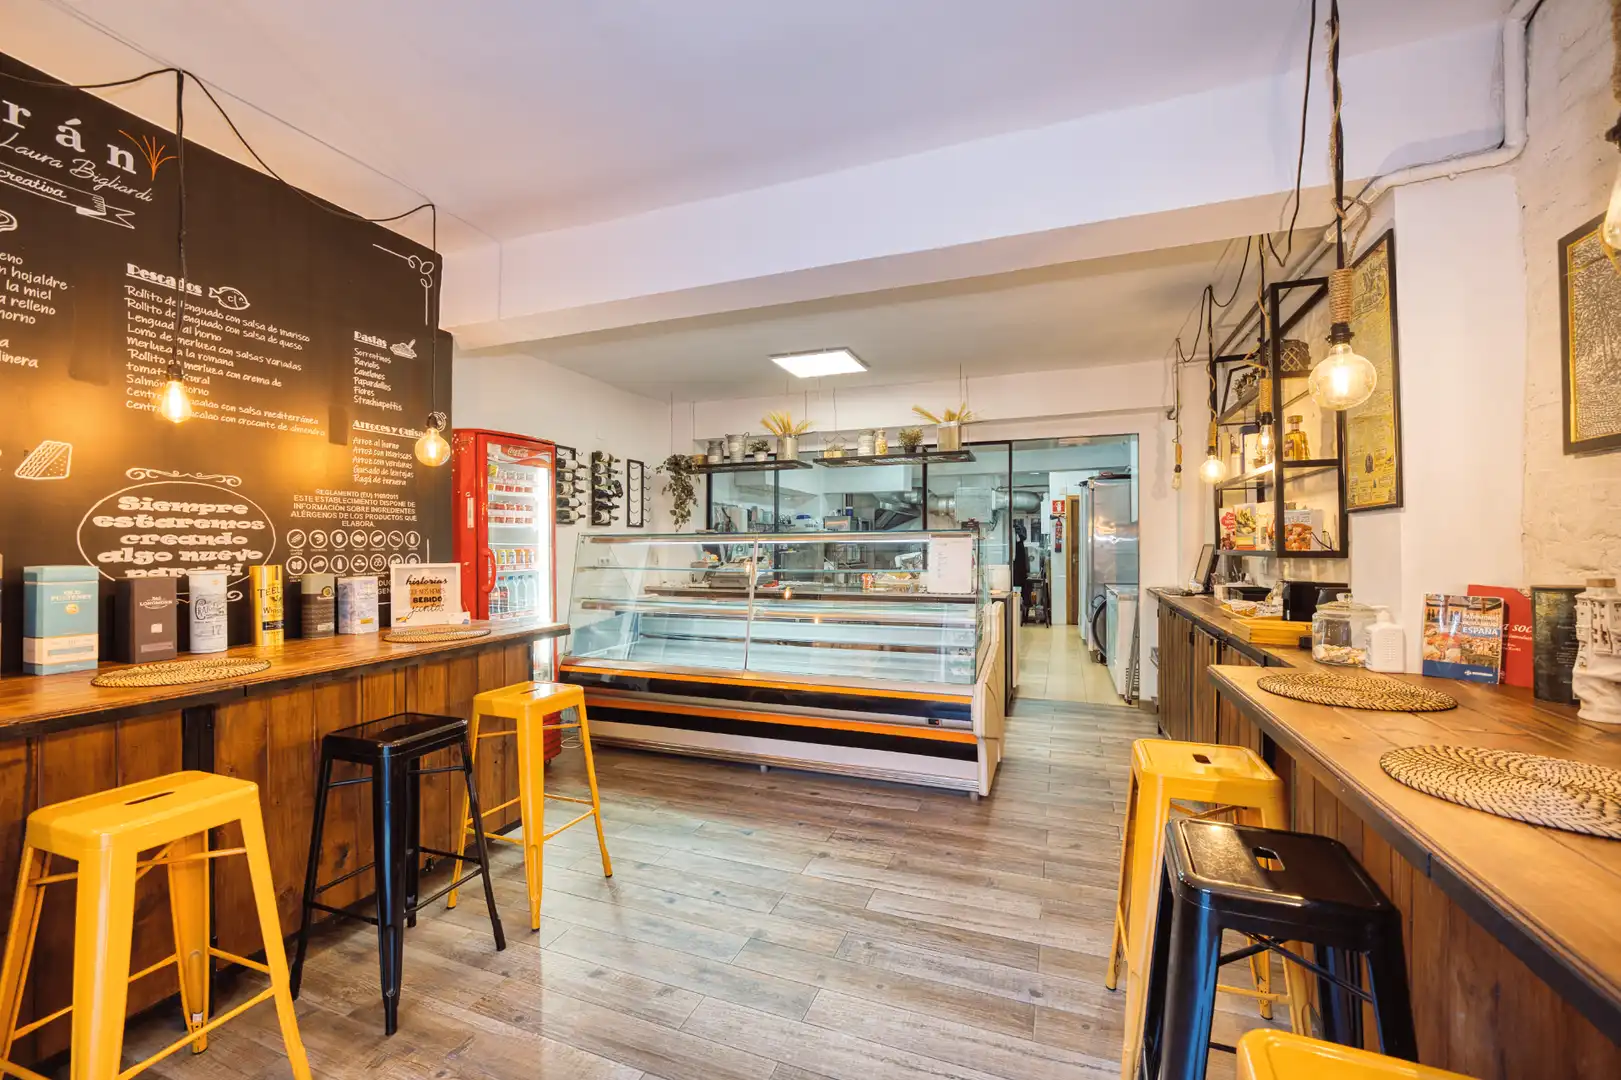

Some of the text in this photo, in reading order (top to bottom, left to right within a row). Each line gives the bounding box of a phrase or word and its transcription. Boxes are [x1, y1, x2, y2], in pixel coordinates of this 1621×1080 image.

[0, 132, 153, 202] Laura Bigliardi
[11, 265, 68, 290] hojaldre
[126, 263, 203, 295] Pescados
[5, 279, 52, 301] la miel
[10, 297, 56, 316] relleno
[124, 285, 163, 303] Rollito
[164, 296, 177, 307] de
[225, 314, 241, 324] con
[242, 319, 266, 331] salsa
[267, 324, 278, 334] de
[279, 328, 310, 342] marisco
[124, 297, 303, 351] Rollito de enguado con salsa de queso
[127, 311, 222, 342] Lenguad al horno
[127, 323, 157, 338] Lomo
[159, 331, 173, 342] de
[177, 337, 217, 352] merluza
[218, 346, 234, 356] con
[235, 350, 264, 363] salsas
[354, 330, 388, 349] Pastas
[185, 348, 196, 359] la
[197, 353, 235, 367] romana
[126, 348, 166, 365] Rollito
[183, 361, 224, 376] merluza
[225, 370, 241, 380] con
[242, 374, 270, 386] crema
[271, 378, 282, 387] de
[126, 374, 166, 388] Salmón
[353, 386, 375, 397] Flores
[220, 403, 236, 413] con
[238, 406, 262, 416] salsa
[263, 410, 319, 425] mediterránea
[220, 414, 236, 424] con
[238, 418, 276, 430] crocante
[277, 422, 289, 432] de
[352, 420, 391, 433] Arroces
[352, 436, 400, 450] Arroz al horno
[353, 446, 373, 455] Arroz
[373, 449, 385, 457] con
[352, 456, 374, 465] Arroz
[374, 458, 385, 466] con
[353, 464, 380, 475] Guisado
[380, 468, 389, 476] de
[372, 476, 382, 484] de
[293, 494, 314, 503] ESTE
[314, 495, 379, 506] ESTABLECIMIENTO
[379, 499, 407, 507] DISPONE
[315, 488, 360, 498] REGLAMENTO
[117, 496, 249, 515] Siempre
[293, 502, 416, 515] INFORMACIÓN SOBRE INGREDIENTES
[92, 514, 266, 530] estaremos
[290, 509, 338, 519] ALÉRGENOS
[349, 512, 364, 520] LOS
[364, 513, 404, 521] PRODUCTOS
[119, 532, 249, 546] creando
[96, 547, 264, 565] algo nuevo
[405, 574, 448, 586] historias
[412, 595, 443, 604] BEBIDO
[1462, 626, 1498, 636] ESPAÑA
